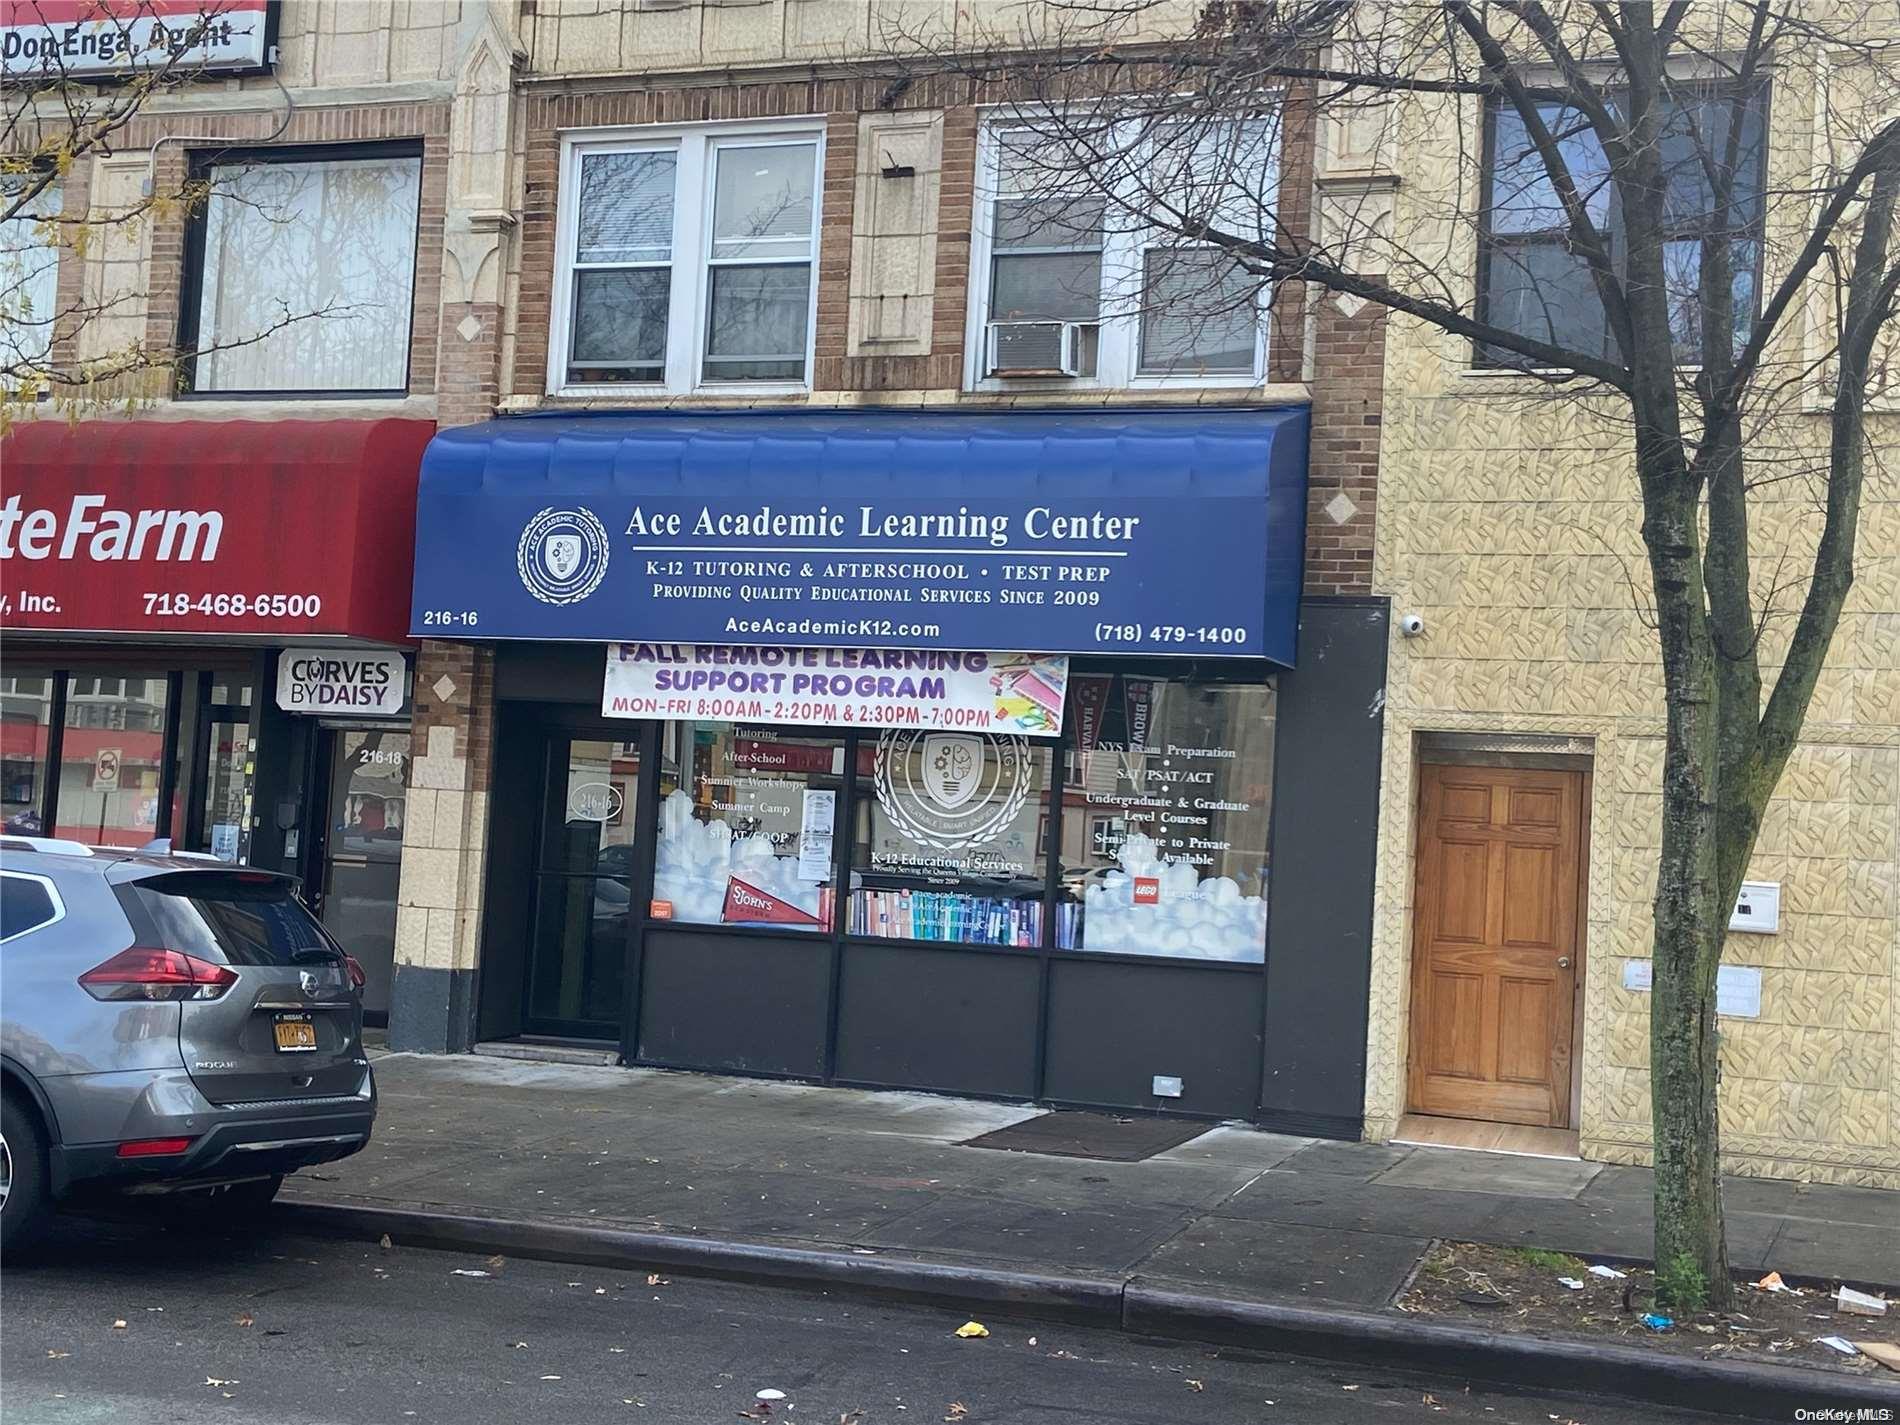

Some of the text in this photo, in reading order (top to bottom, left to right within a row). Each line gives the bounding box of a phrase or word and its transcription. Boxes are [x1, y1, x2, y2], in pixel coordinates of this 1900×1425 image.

[625, 505, 1140, 547] Ace Academic Learning Center
[646, 561, 1111, 582] K-12 TUTORING & AFTERSCHOOL TEST PREP
[20, 591, 62, 613] Inc.
[143, 593, 321, 617] 718-468-6500
[1053, 591, 1100, 606] 2009
[423, 611, 479, 626] 216-16
[724, 617, 941, 638] AceAcademicK12.com
[1094, 623, 1247, 644] (718) 479-1400
[619, 643, 989, 673] FALL REMOTE LEARNING
[291, 657, 389, 684] CURVES
[654, 669, 946, 700] SUPPORT PROGRAM
[612, 696, 692, 714] MON-FRI
[843, 704, 854, 722] &
[734, 727, 778, 740] Tutoring
[359, 749, 401, 765] 216-18
[722, 753, 786, 765] After-School
[1098, 741, 1123, 752] NYS
[1167, 745, 1236, 759] Preparation
[701, 774, 807, 790] Summer Workshops
[711, 800, 791, 816] Summer Camp
[1086, 793, 1249, 811] Undergraduate & Graduate
[1124, 810, 1208, 825] Level Courses
[1172, 839, 1184, 848] to
[1189, 837, 1231, 850] Private
[871, 851, 1023, 871] K-12 Educational Services
[1163, 852, 1214, 865] Available
